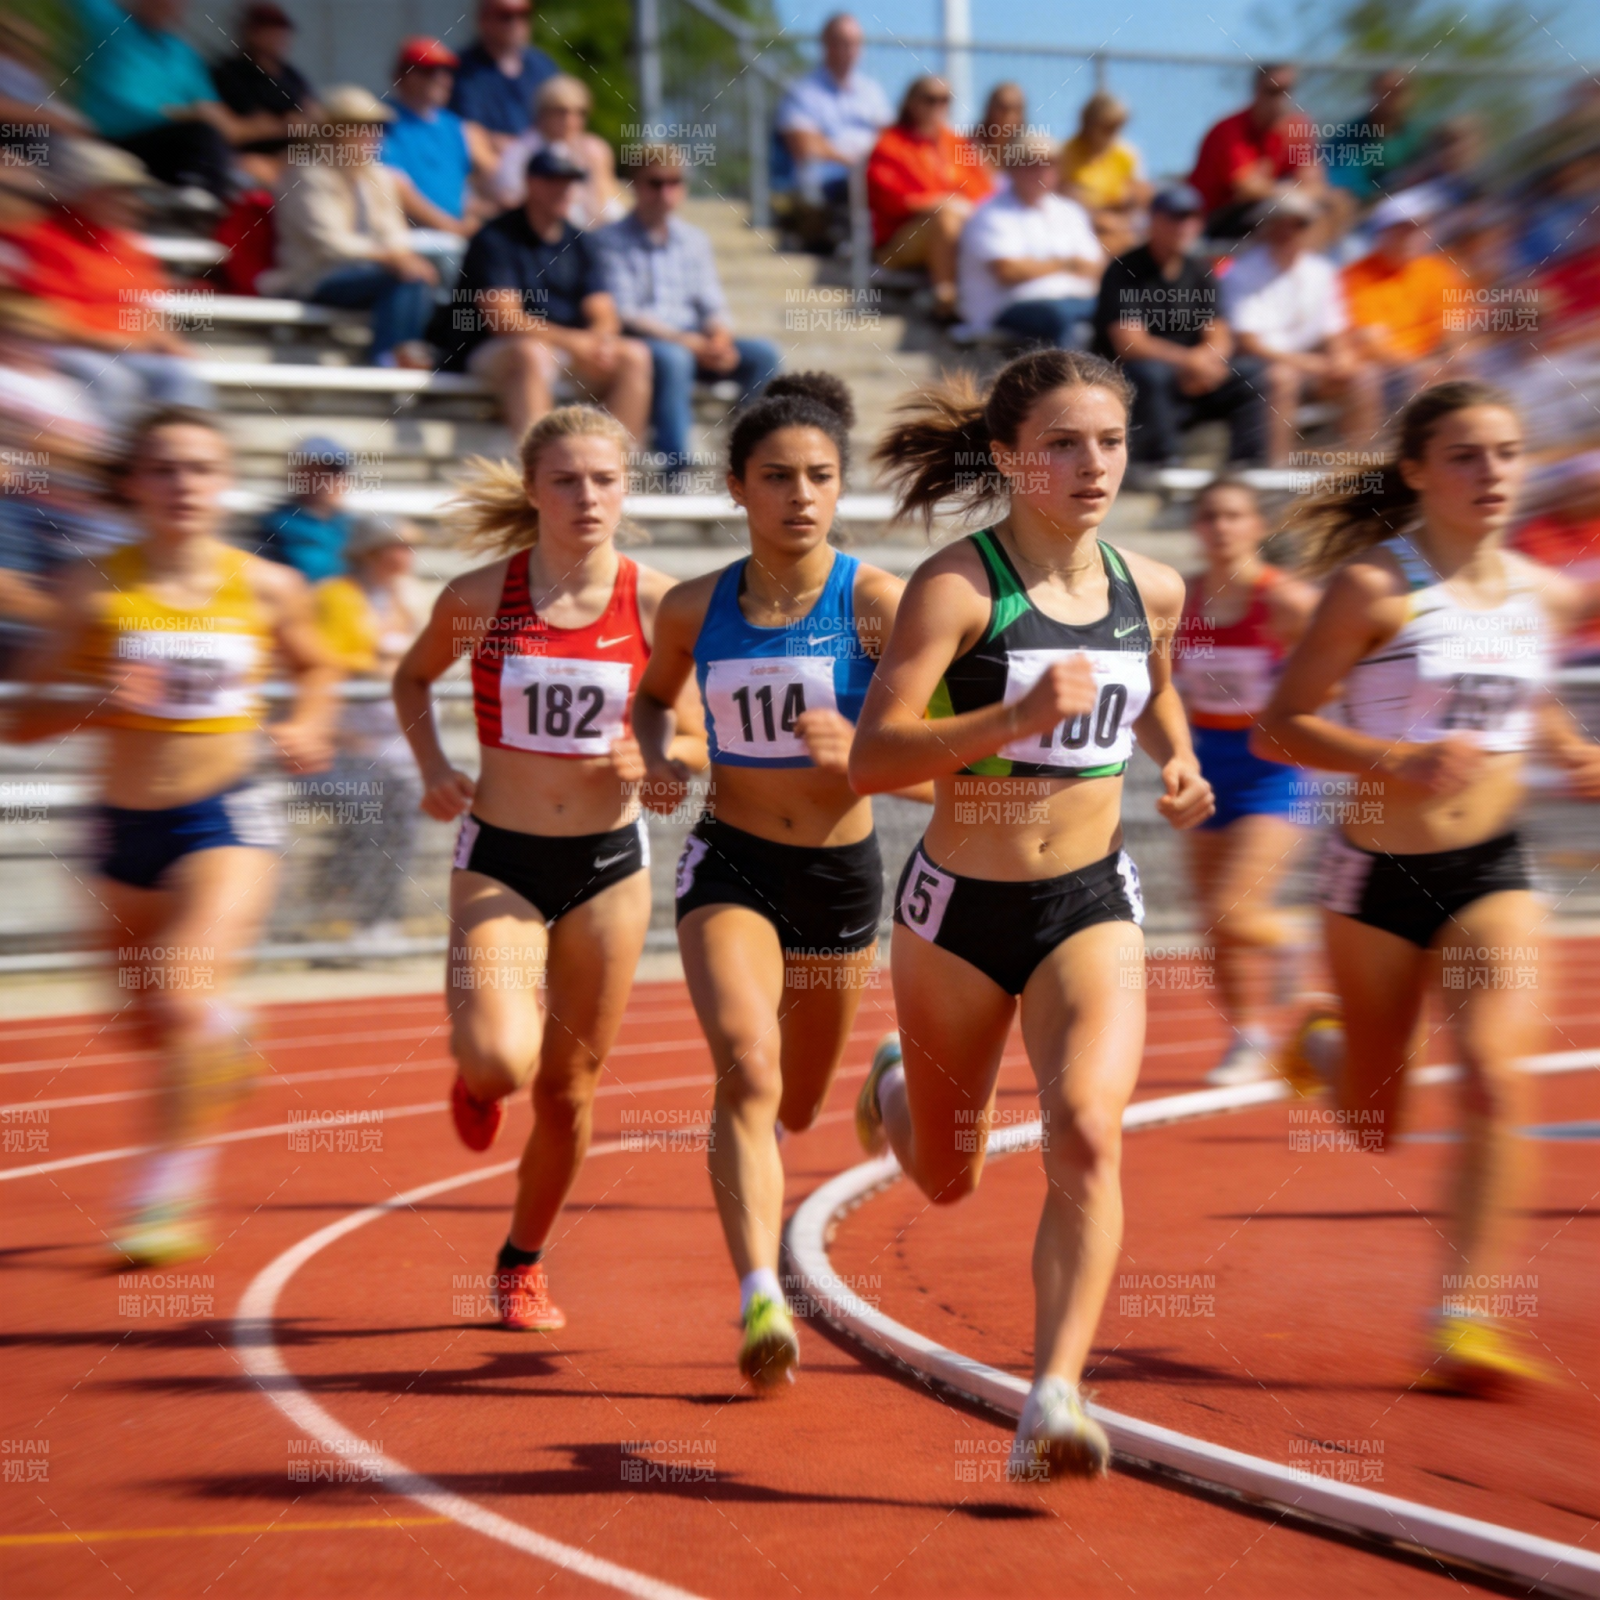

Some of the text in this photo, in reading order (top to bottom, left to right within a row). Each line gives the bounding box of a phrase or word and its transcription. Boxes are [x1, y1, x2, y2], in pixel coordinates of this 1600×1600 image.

[523, 682, 605, 739] 182
[732, 682, 807, 742] 114
[908, 870, 940, 926] 5
